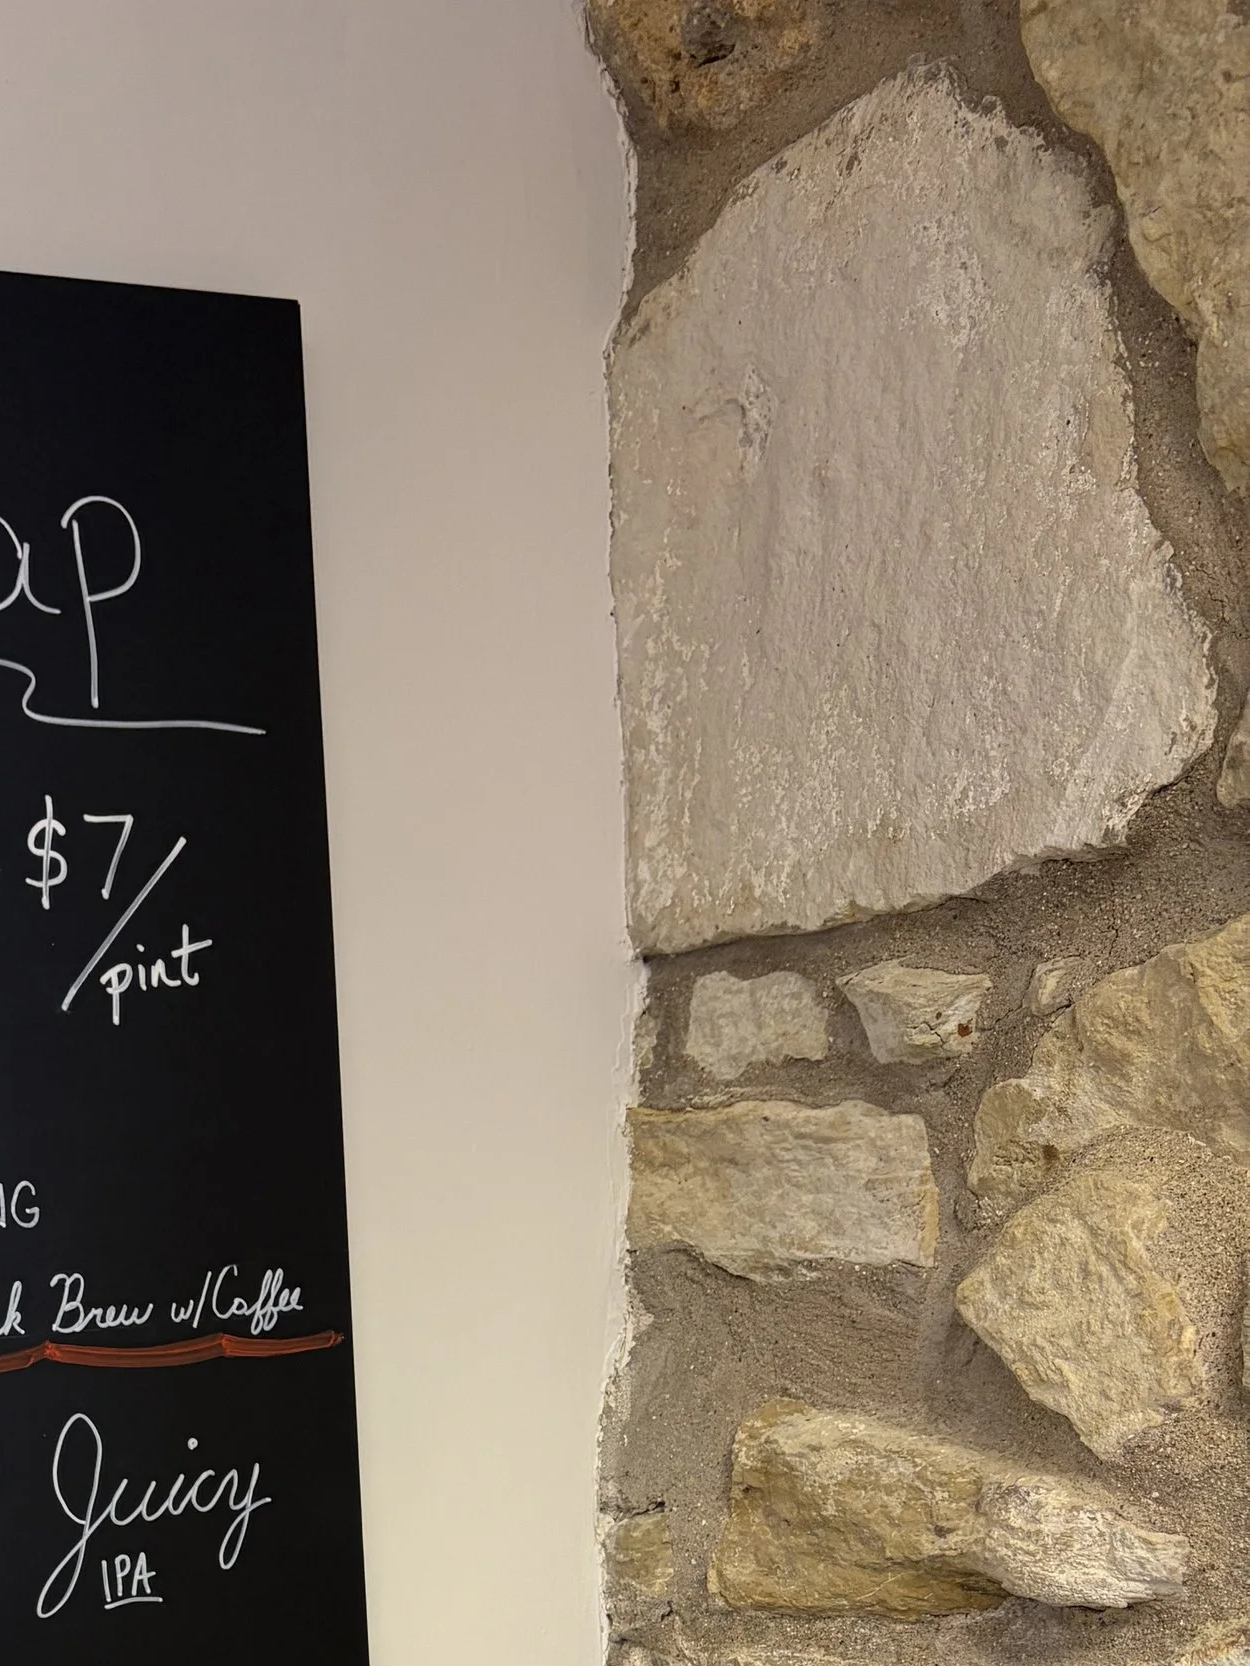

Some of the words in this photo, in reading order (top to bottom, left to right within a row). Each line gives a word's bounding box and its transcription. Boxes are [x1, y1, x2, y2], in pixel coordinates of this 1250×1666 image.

[49, 1272, 154, 1334] Brew
[36, 1412, 272, 1619] Juicy
[101, 1551, 164, 1602] IPA
